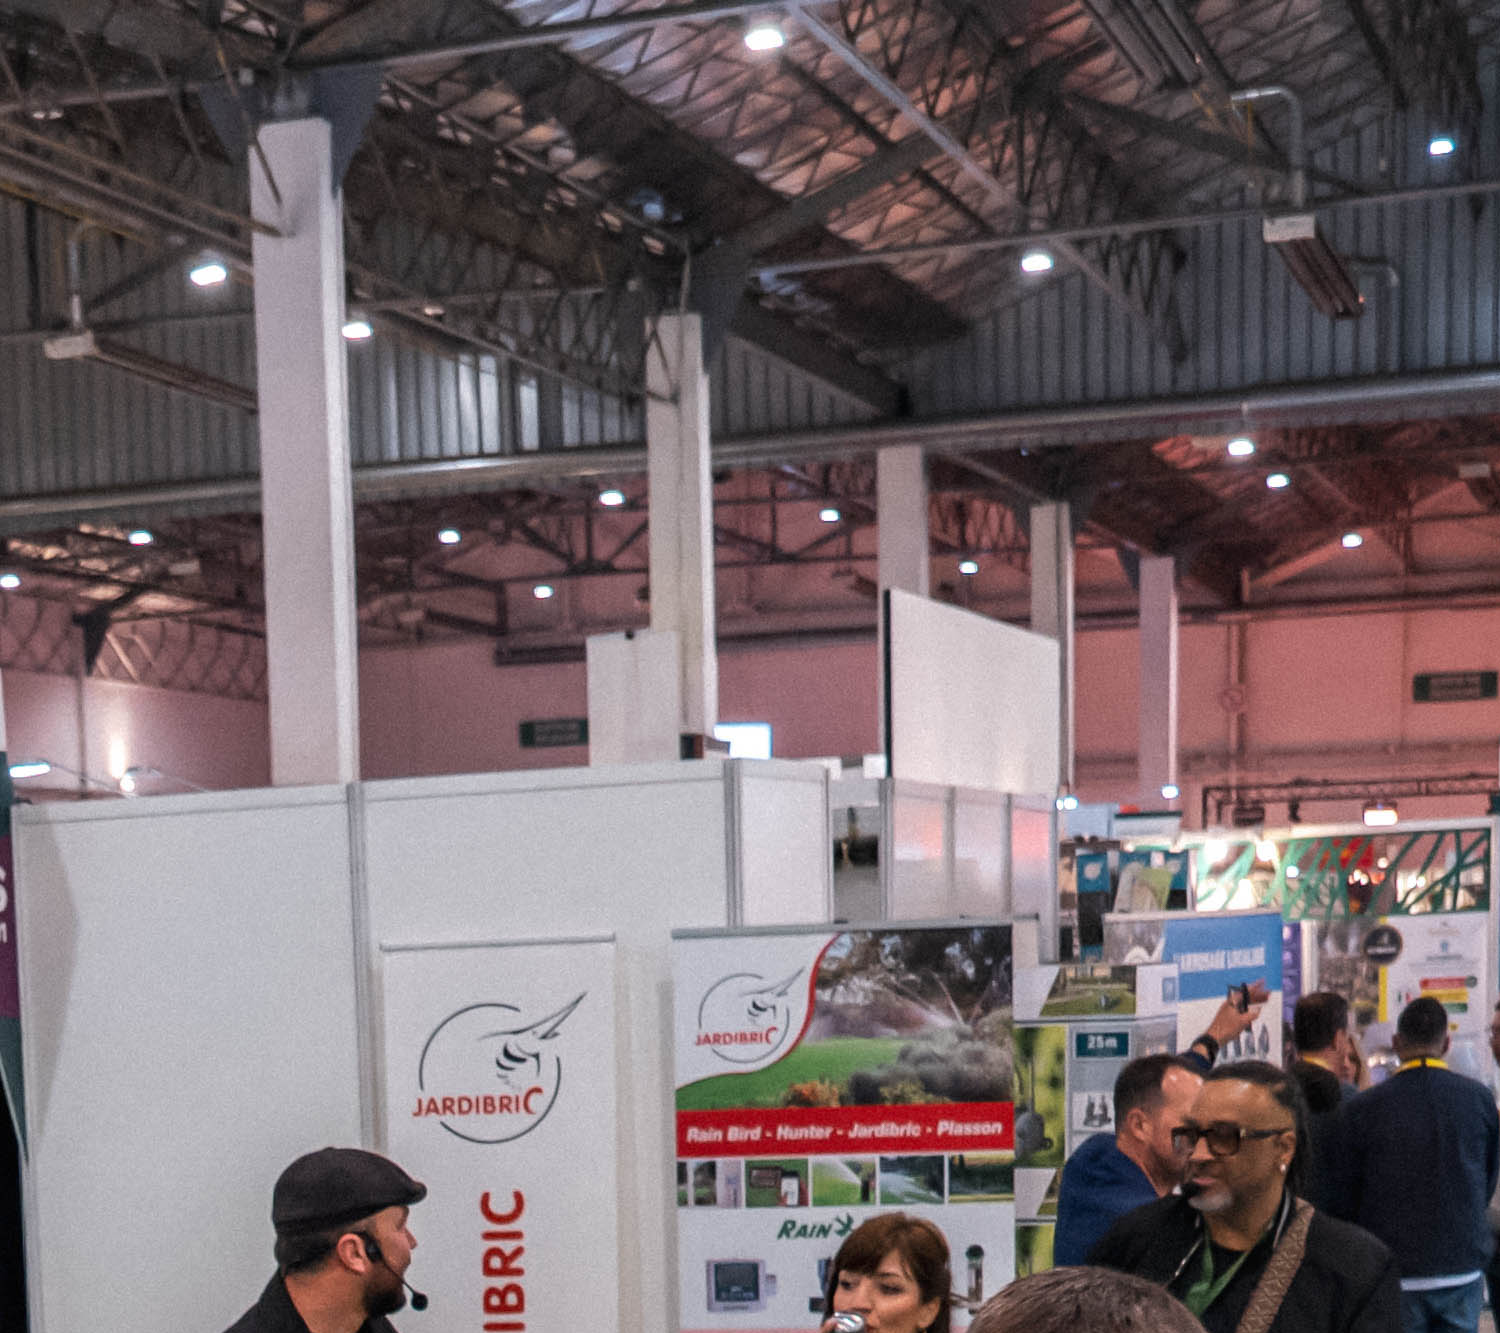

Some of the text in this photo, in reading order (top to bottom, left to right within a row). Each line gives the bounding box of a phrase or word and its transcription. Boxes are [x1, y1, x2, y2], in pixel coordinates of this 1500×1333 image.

[696, 1027, 778, 1046] JARDIBRIC
[1087, 1034, 1118, 1049] 25m
[412, 1086, 543, 1117] JARDIBRIC
[687, 1126, 723, 1143] Rain
[727, 1124, 762, 1141] Bird
[776, 1122, 832, 1141] Hunter
[848, 1120, 922, 1140] Jardibric
[936, 1119, 1003, 1137] Plasson
